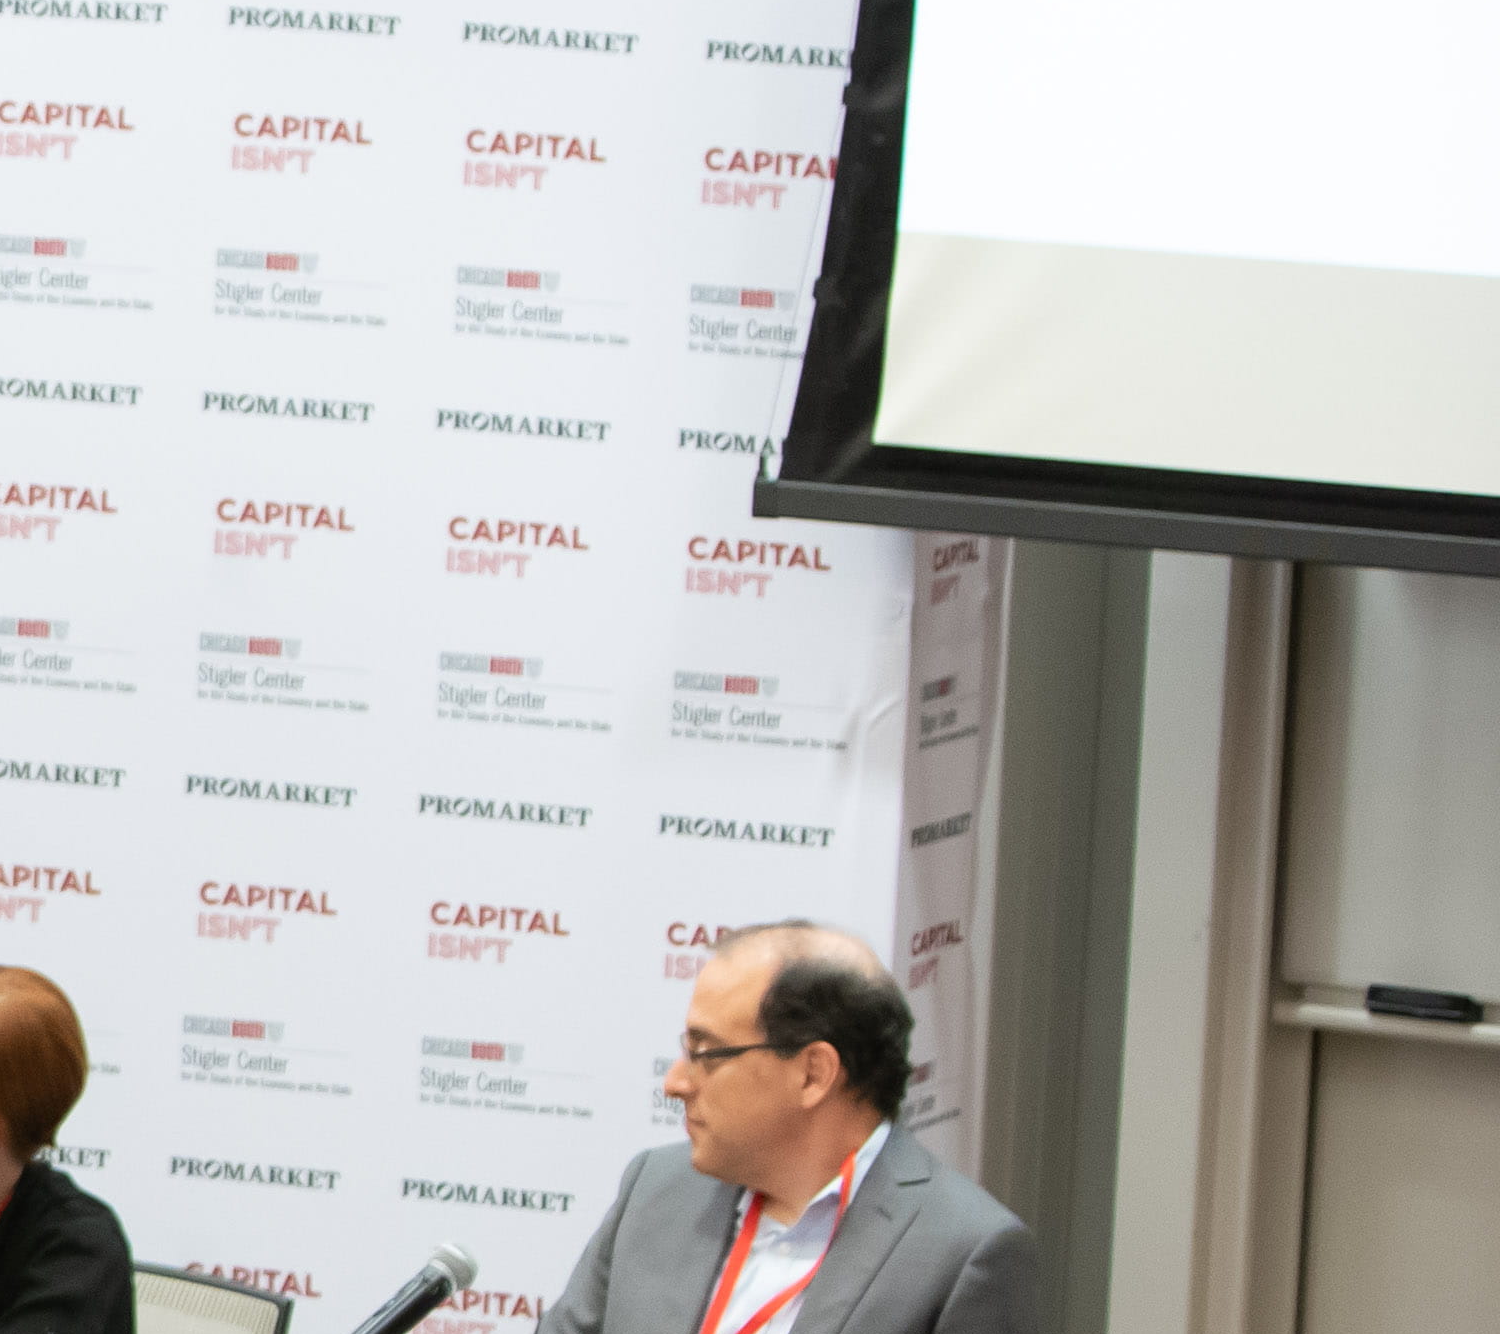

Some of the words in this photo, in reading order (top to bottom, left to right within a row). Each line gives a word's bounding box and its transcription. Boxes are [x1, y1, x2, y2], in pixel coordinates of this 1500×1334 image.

[226, 6, 400, 37] PROMARKET
[460, 21, 638, 55] PROMARKET
[705, 38, 846, 68] PROMARK
[231, 111, 374, 147] CAPITAL
[463, 127, 608, 165] CAPITAL
[200, 391, 374, 424] PROMARKET
[434, 408, 610, 443] PROMARKET
[678, 427, 777, 455] PROMA
[214, 496, 357, 534] CAPITAL
[446, 514, 591, 553] CAPITAL
[685, 534, 833, 573] CAPITAL
[183, 774, 357, 809] PROMARKET
[416, 793, 592, 829] PROMARKET
[656, 813, 835, 849] PROMARKET
[197, 879, 339, 918] CAPITAL
[428, 899, 572, 938] CAPITAL
[167, 1155, 340, 1192] PROMARKET
[399, 1177, 576, 1214] PROMARKET
